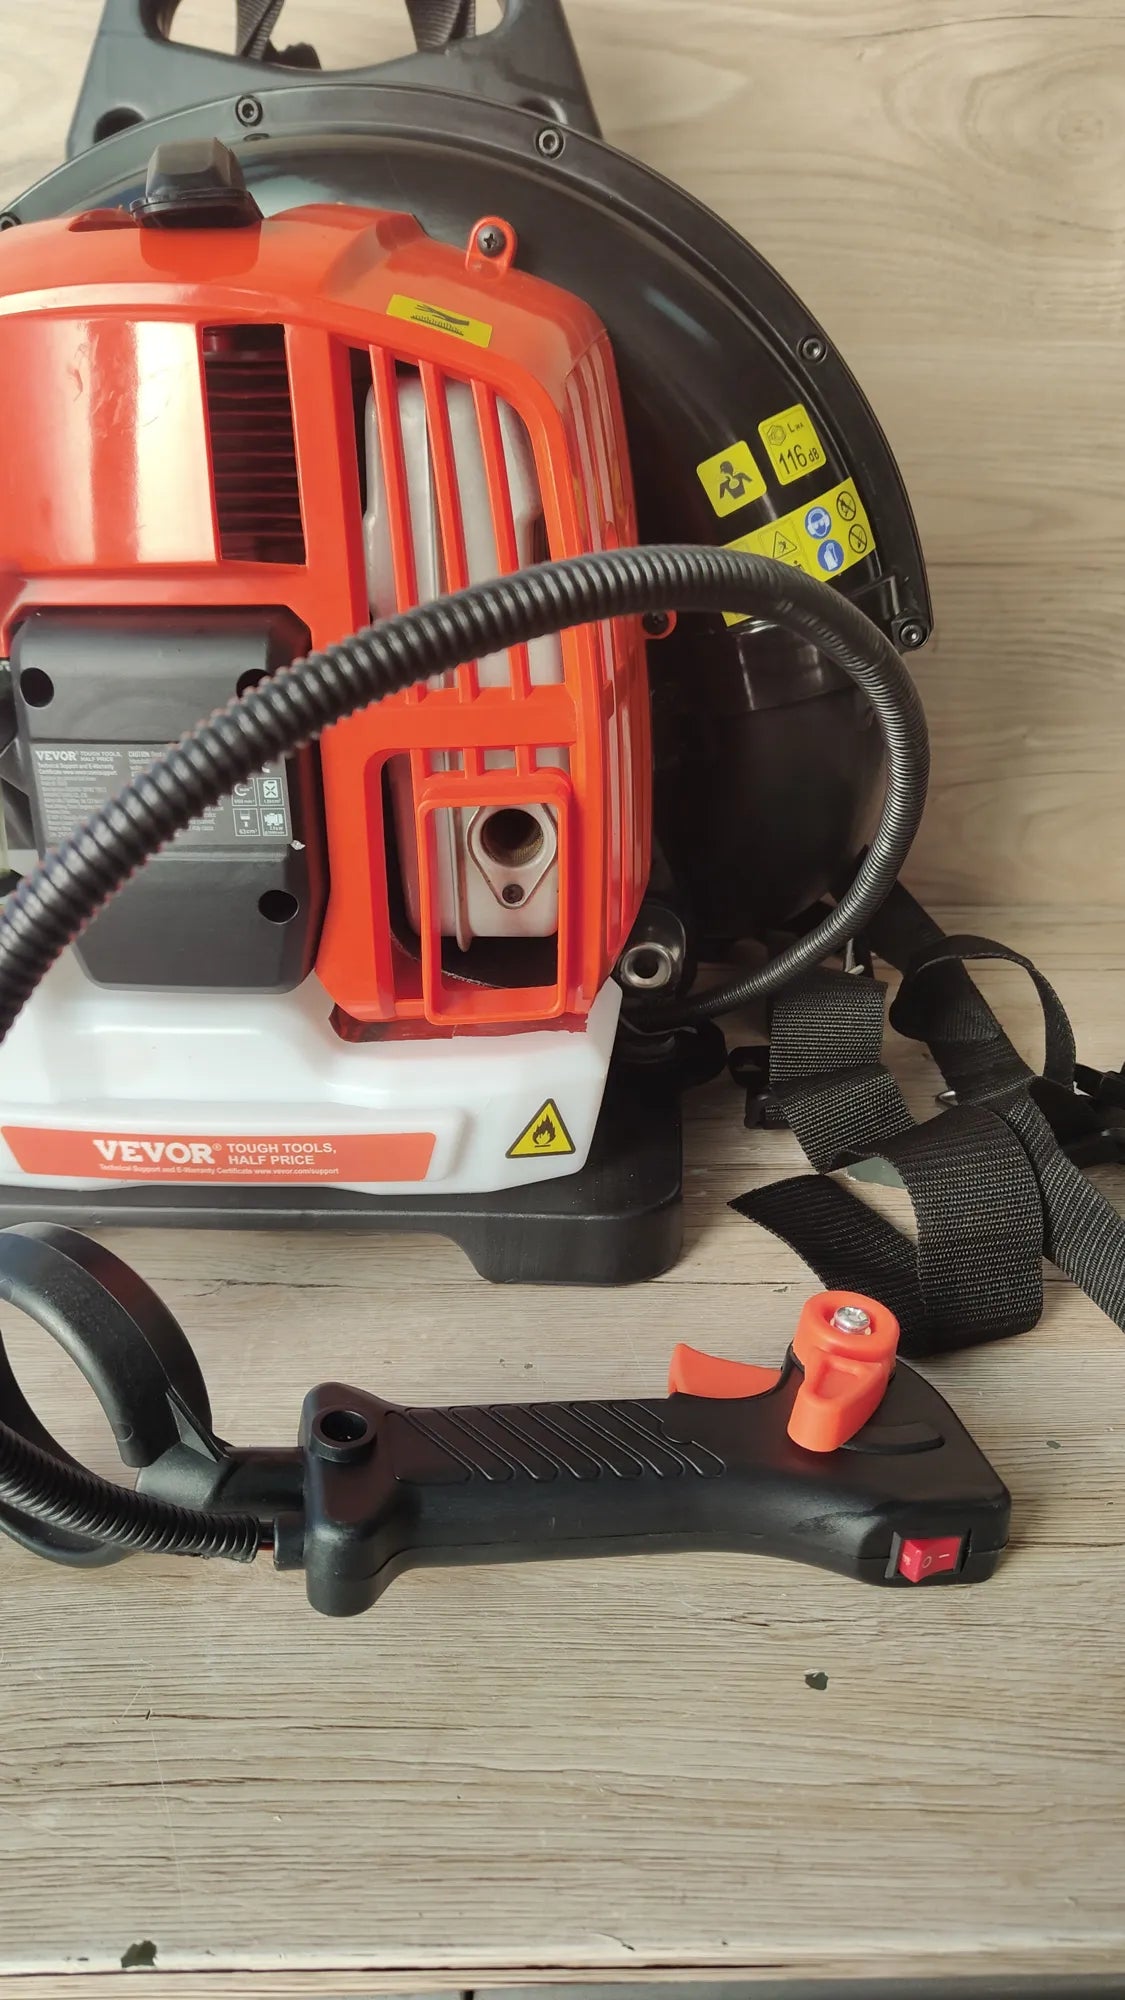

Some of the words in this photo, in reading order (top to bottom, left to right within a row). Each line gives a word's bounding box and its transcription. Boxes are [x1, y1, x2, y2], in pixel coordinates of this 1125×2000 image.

[779, 444, 807, 475] 116
[226, 1143, 279, 1153] TOUGH
[281, 1143, 337, 1154] TOOLS,
[228, 1155, 267, 1165] HALF
[270, 1155, 315, 1165] PRICE
[132, 1165, 161, 1173] Support
